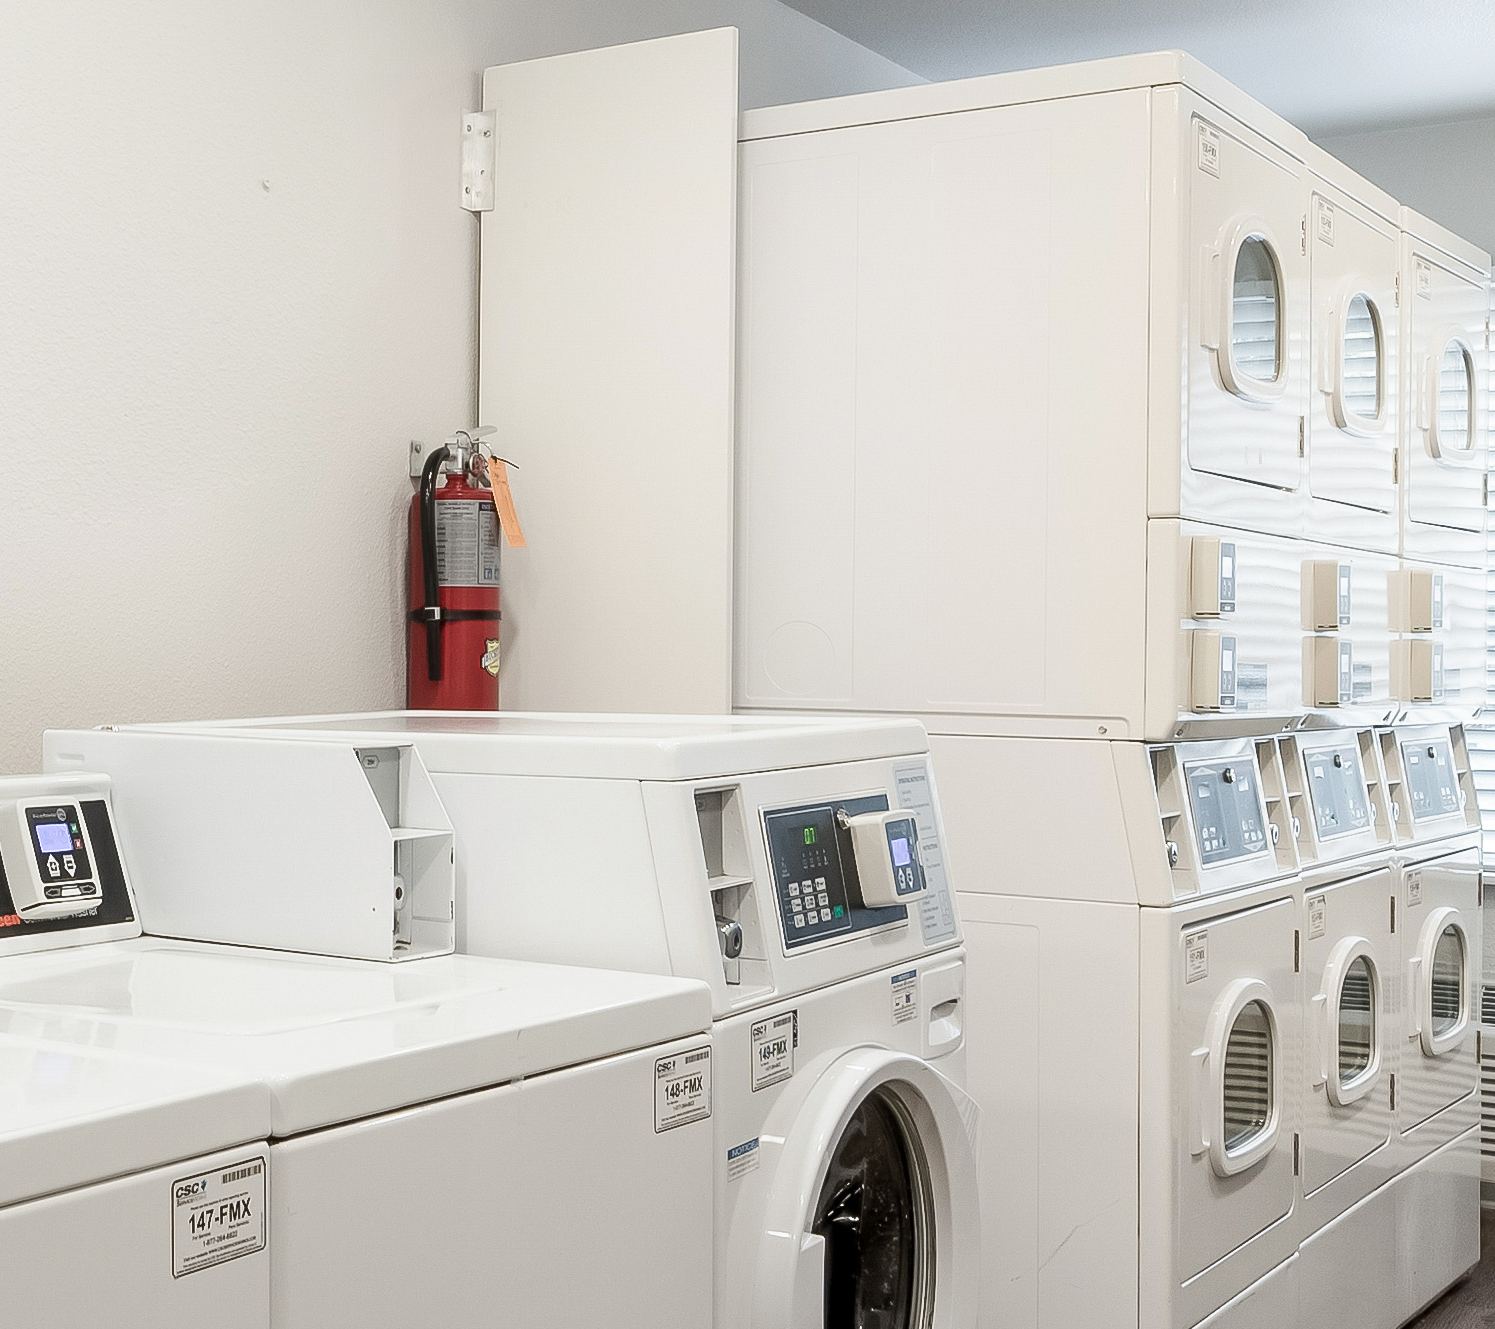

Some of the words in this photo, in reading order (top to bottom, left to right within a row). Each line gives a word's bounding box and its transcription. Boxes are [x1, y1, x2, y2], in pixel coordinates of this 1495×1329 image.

[665, 1075, 703, 1101] 148-FMX
[176, 1182, 200, 1198] CSC
[188, 1197, 252, 1234] 147-FMX
